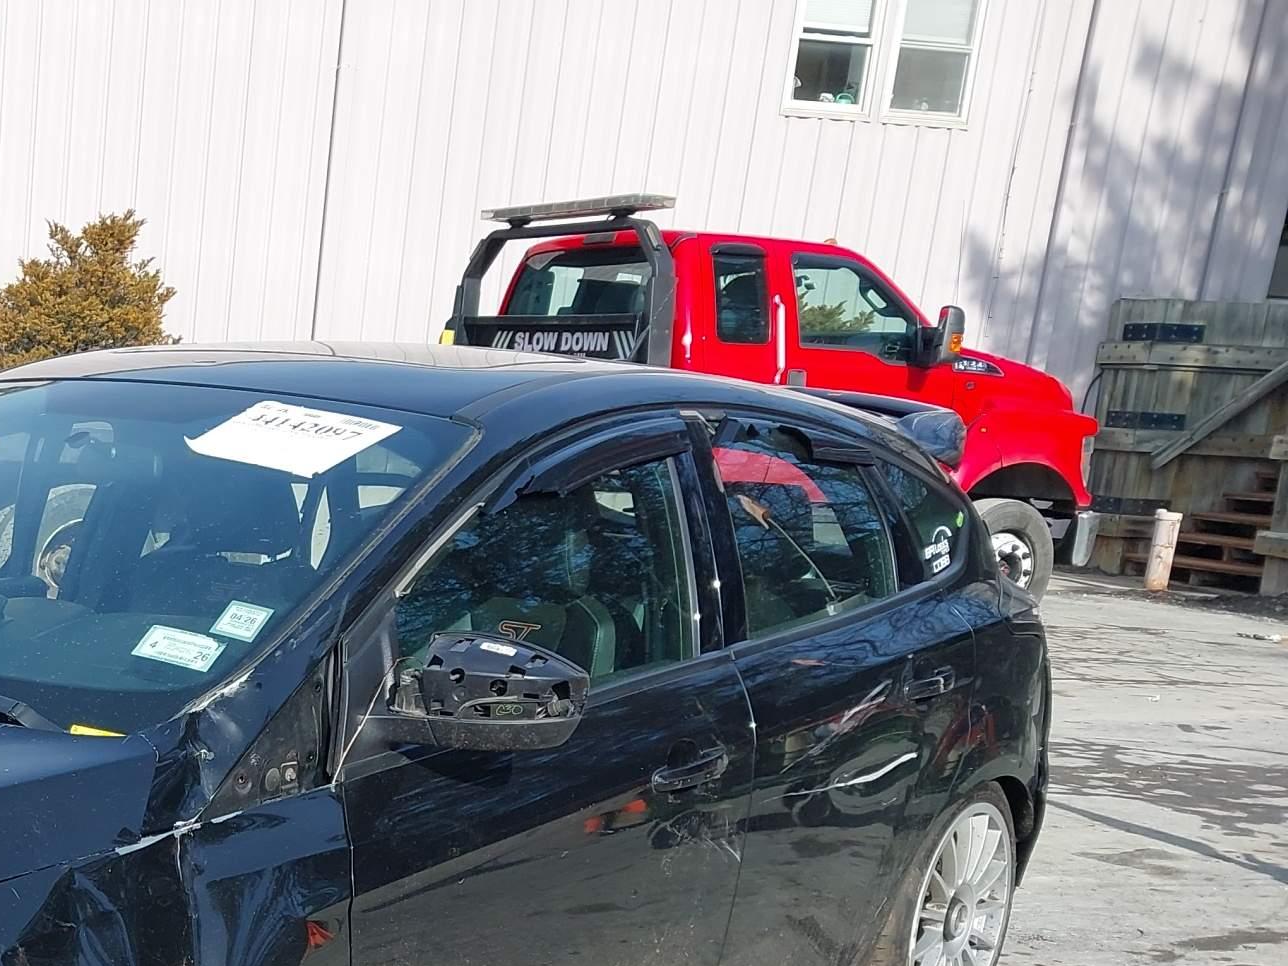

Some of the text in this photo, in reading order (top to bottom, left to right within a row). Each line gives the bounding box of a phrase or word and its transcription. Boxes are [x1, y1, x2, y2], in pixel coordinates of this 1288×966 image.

[514, 331, 610, 352] SLOW DOWN
[498, 620, 542, 641] ST
[149, 640, 158, 649] 4
[193, 650, 209, 662] 26
